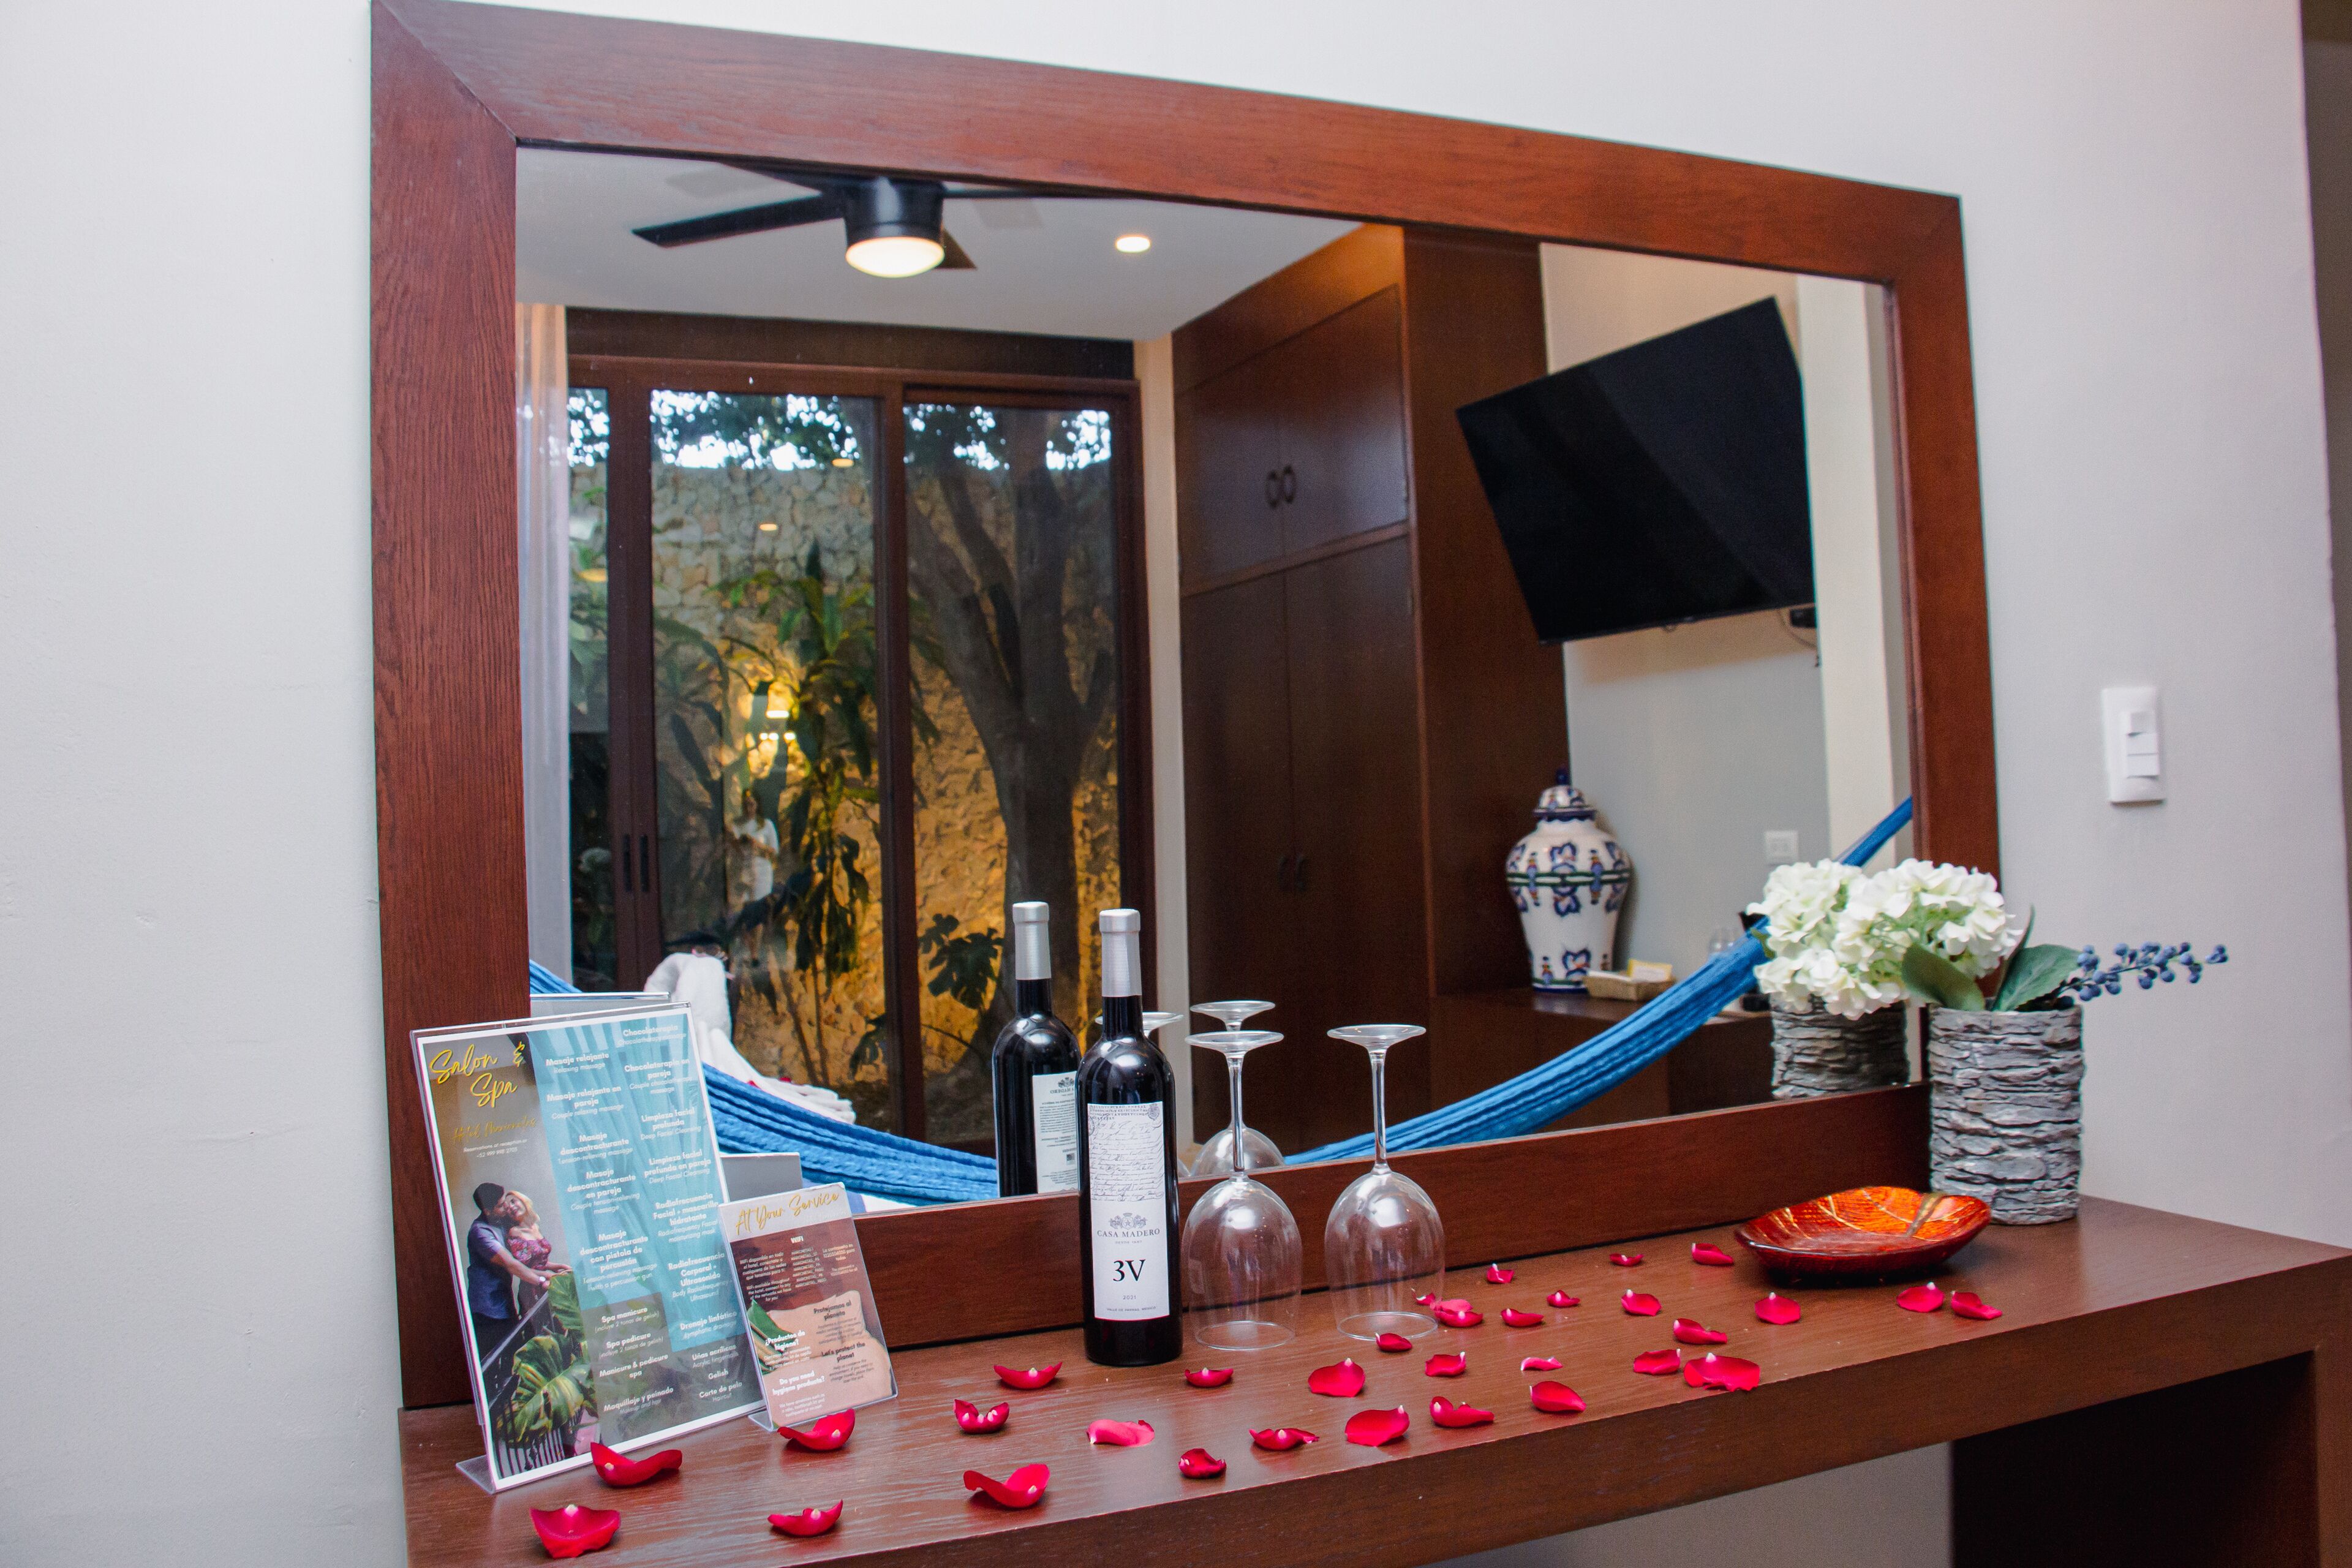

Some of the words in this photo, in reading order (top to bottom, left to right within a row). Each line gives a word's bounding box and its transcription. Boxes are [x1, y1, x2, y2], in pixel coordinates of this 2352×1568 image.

[623, 1025, 678, 1036] Chocolaterapia
[430, 1044, 498, 1084] Salon
[513, 1041, 525, 1067] &
[546, 1057, 574, 1066] Masaje
[576, 1053, 609, 1062] relajante
[624, 1059, 679, 1072] Chocolaterapia
[647, 1070, 671, 1080] pareja
[470, 1073, 518, 1107] Spa
[546, 1092, 575, 1101] Masaje
[577, 1087, 610, 1097] relajante
[574, 1098, 598, 1109] pareja
[552, 1110, 573, 1119] Couple
[641, 1112, 673, 1121] Limpieza
[674, 1107, 695, 1116] facial
[652, 1118, 684, 1131] profunda
[579, 1132, 608, 1142] Masaje
[560, 1139, 629, 1155] descontracturante
[649, 1155, 680, 1165] Limpieza
[682, 1148, 703, 1159] facial
[586, 1169, 614, 1178] Masaje
[644, 1164, 677, 1178] profunda
[688, 1158, 711, 1169] pareja
[567, 1175, 636, 1192] descontracturante
[597, 1186, 622, 1199] pareja
[655, 1193, 713, 1209] Radiofrecuencia
[594, 1205, 619, 1214] massage
[653, 1208, 676, 1219] Facial
[682, 1200, 719, 1213] mascarilla
[753, 1205, 784, 1230] Your
[789, 1193, 839, 1216] Service
[669, 1213, 707, 1226] hidratante
[598, 1230, 627, 1241] Masaje
[1122, 1228, 1160, 1238] MADERO
[580, 1236, 648, 1256] descontracturante
[606, 1249, 631, 1262] pistola
[668, 1253, 725, 1270] Radiofrecuencia
[632, 1263, 657, 1273] massage
[680, 1263, 712, 1276] Corporal
[1113, 1259, 1146, 1282] 3V
[680, 1272, 720, 1286] Ultrasonido
[690, 1289, 719, 1302] Ultrasound
[601, 1314, 615, 1323] Spa
[617, 1307, 648, 1319] manicure
[813, 1303, 845, 1314] Protejamos
[680, 1319, 707, 1330] Drenaje
[708, 1311, 737, 1323] linfático
[824, 1311, 845, 1321] planeta
[595, 1324, 614, 1333] (incluye
[621, 1332, 651, 1344] pedicure
[766, 1333, 797, 1346] ¿Productos
[774, 1339, 799, 1351] higiene?
[835, 1344, 855, 1354] protect
[599, 1349, 618, 1359] (incluye
[837, 1352, 854, 1362] planet
[600, 1365, 631, 1377] Manicure
[639, 1354, 668, 1367] pedicure
[693, 1359, 710, 1368] Acrylic
[708, 1368, 728, 1379] Gelish
[800, 1370, 815, 1379] need
[699, 1389, 717, 1398] Corte
[728, 1381, 742, 1391] pelo
[772, 1385, 796, 1396] hygiene
[796, 1376, 825, 1390] products?
[604, 1397, 640, 1411] Maquillaje
[647, 1387, 674, 1400] peinado
[712, 1393, 732, 1401] Haircut
